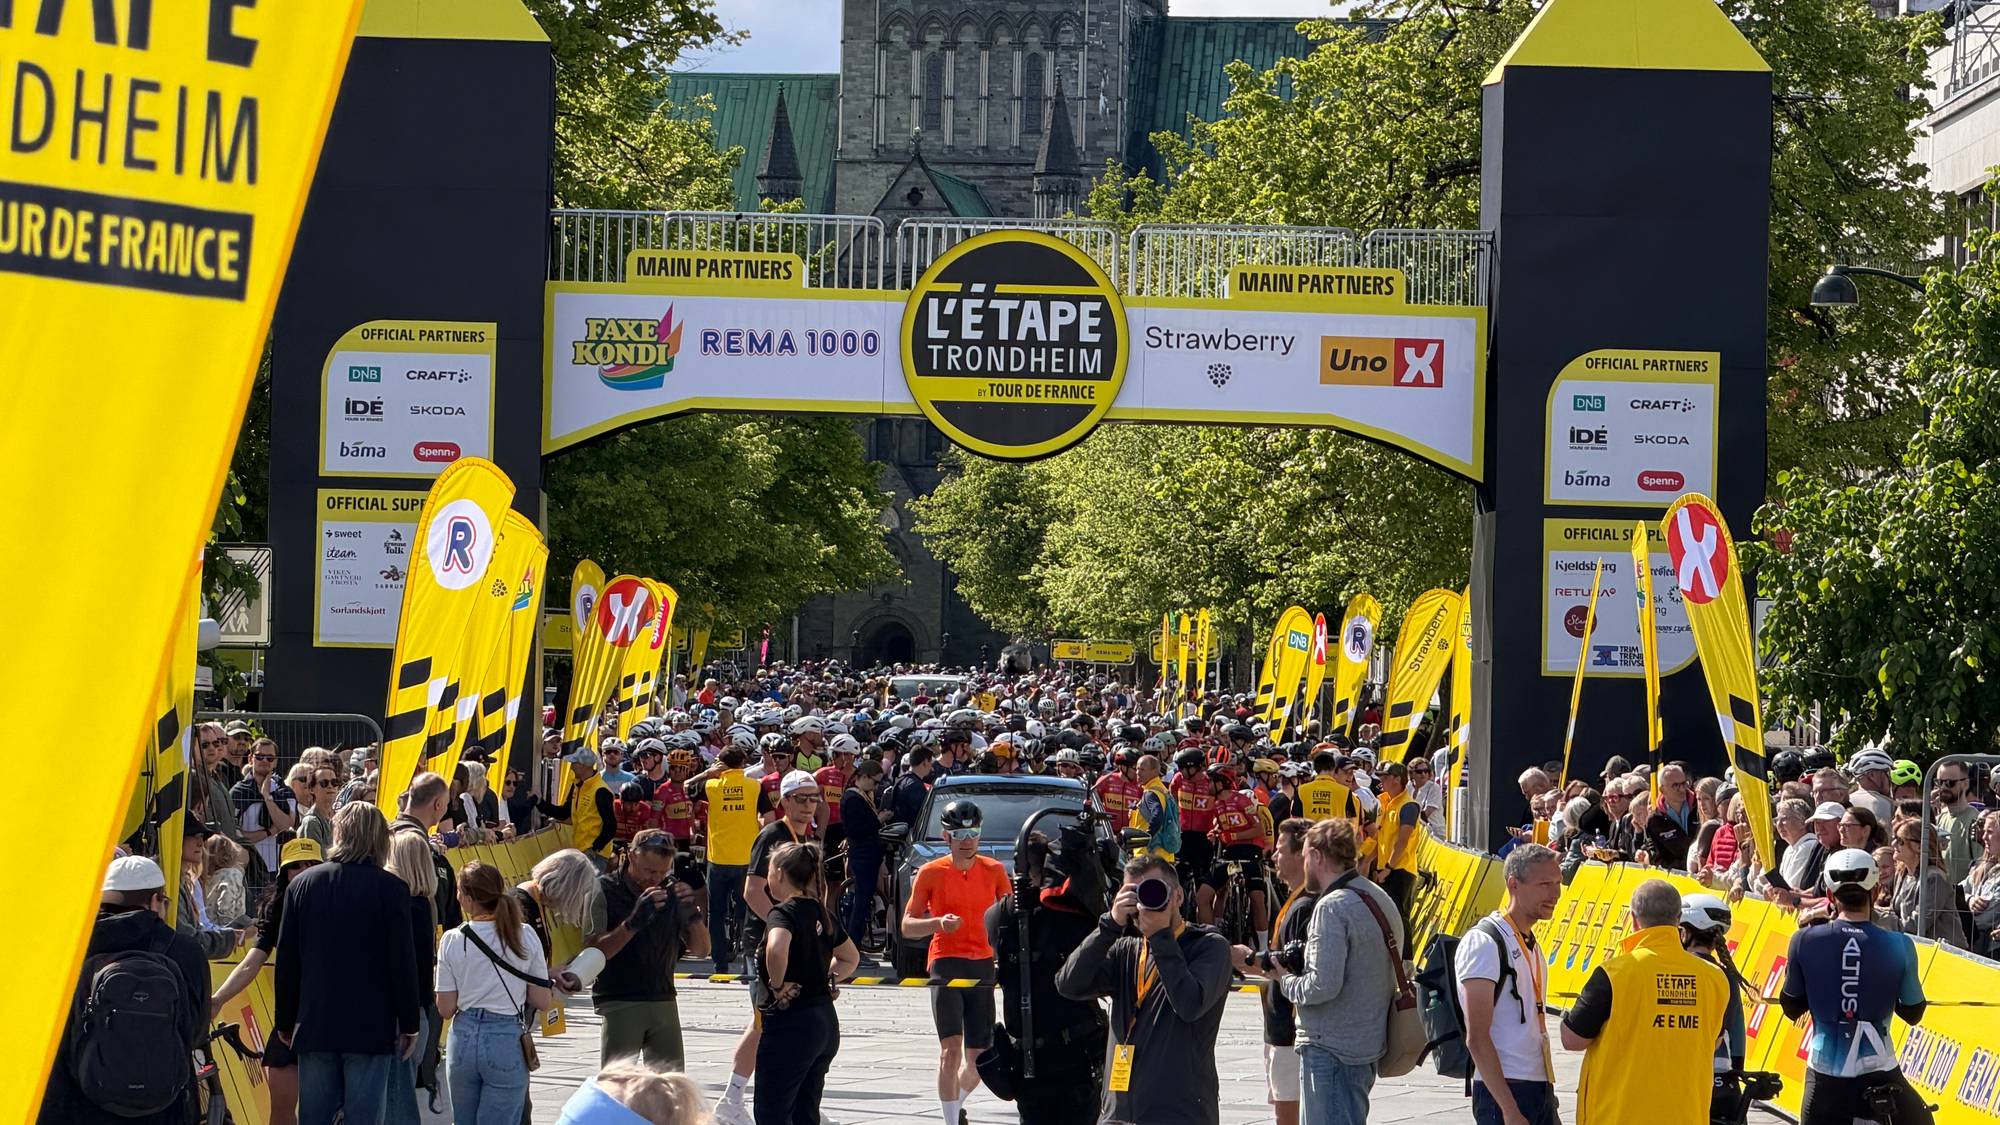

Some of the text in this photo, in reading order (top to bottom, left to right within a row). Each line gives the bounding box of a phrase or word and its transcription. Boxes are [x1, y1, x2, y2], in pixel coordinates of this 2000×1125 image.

[10, 60, 259, 186] DHEIM
[50, 207, 94, 264] DE
[99, 214, 241, 283] FRANCE
[637, 256, 793, 280] MAIN PARTNERS
[1239, 272, 1395, 296] MAIN PARTNERS
[927, 283, 1102, 343] L'ÉTAPE
[361, 328, 485, 343] OFFICIAL PARTNERS
[585, 318, 662, 342] FAXE
[1145, 326, 1295, 356] Strawberry
[572, 340, 670, 366] KONDI
[699, 328, 881, 357] REMA 1000
[927, 344, 1102, 374] TRONDHEIM
[1329, 343, 1440, 384] Uno X
[1585, 357, 1709, 373] OFFICIAL PARTNERS
[352, 368, 378, 382] DNB
[406, 370, 458, 381] CRAFT
[977, 383, 1095, 399] BY TOUR DE FRANCE
[1576, 397, 1603, 410] DNB
[1630, 399, 1682, 411] CRAFT
[326, 496, 388, 511] OFFICIAL
[334, 529, 362, 539] sweet
[443, 516, 476, 574] R
[1564, 527, 1619, 541] OFFICIAL
[1677, 505, 1719, 599] X
[1555, 587, 1610, 598] RETUA
[606, 586, 649, 642] X
[1290, 632, 1308, 649] DNB
[1350, 623, 1367, 655] R
[1409, 603, 1449, 673] Strawberry
[1106, 797, 1122, 805] Uno
[1195, 798, 1207, 808] X
[1657, 989, 1697, 998] TRONDHEIM
[1653, 1014, 1699, 1029] Æ E ME
[1921, 1032, 1962, 1096] 1000
